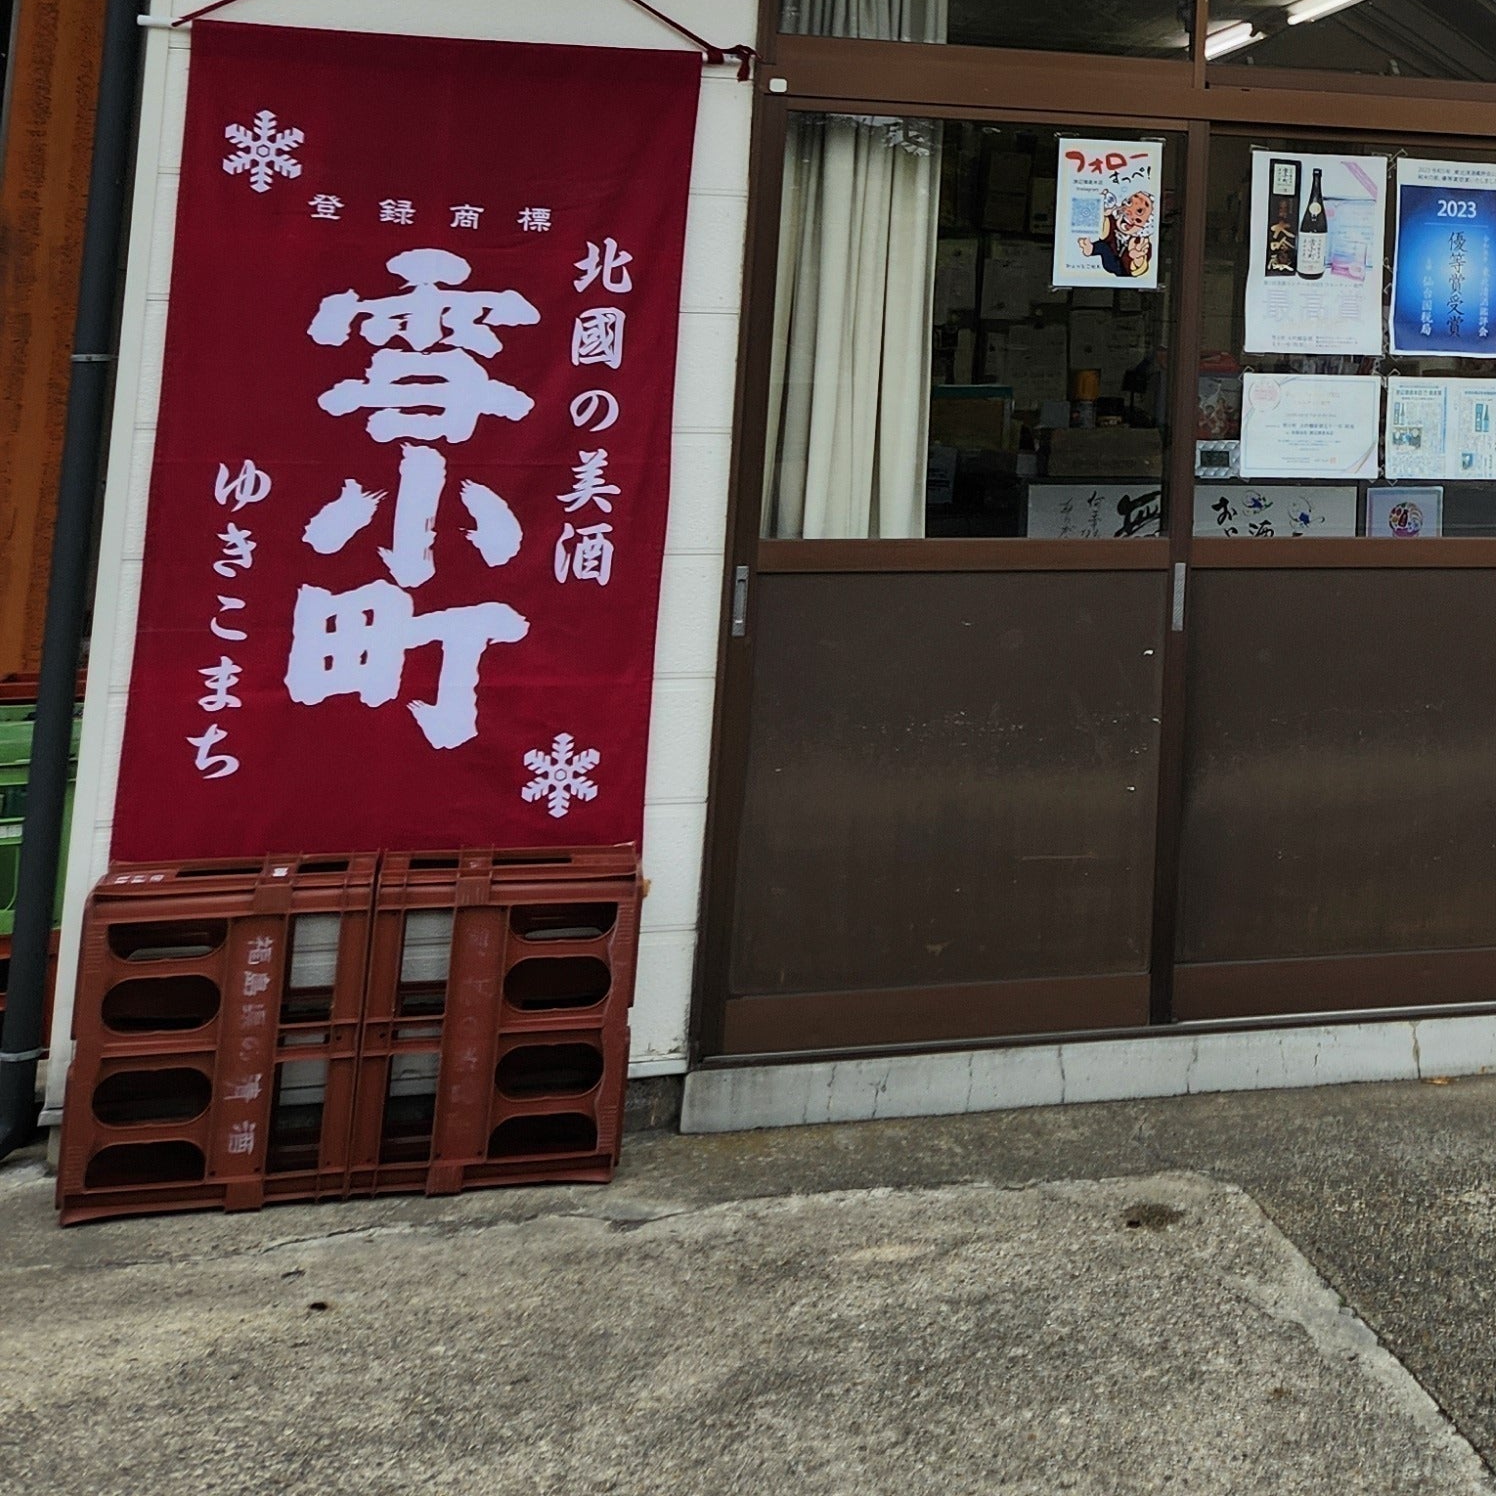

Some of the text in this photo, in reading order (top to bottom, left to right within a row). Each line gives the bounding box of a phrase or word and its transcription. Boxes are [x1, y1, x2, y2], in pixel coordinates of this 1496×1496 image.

[307, 192, 553, 233] 登録商標
[1065, 151, 1149, 174] フォロー
[1437, 200, 1477, 218] 2023
[1447, 231, 1469, 338] 優等賞受賞
[554, 237, 633, 587] 北國の美酒
[284, 247, 541, 751] 雪小町
[185, 458, 272, 780] ゆきこまち
